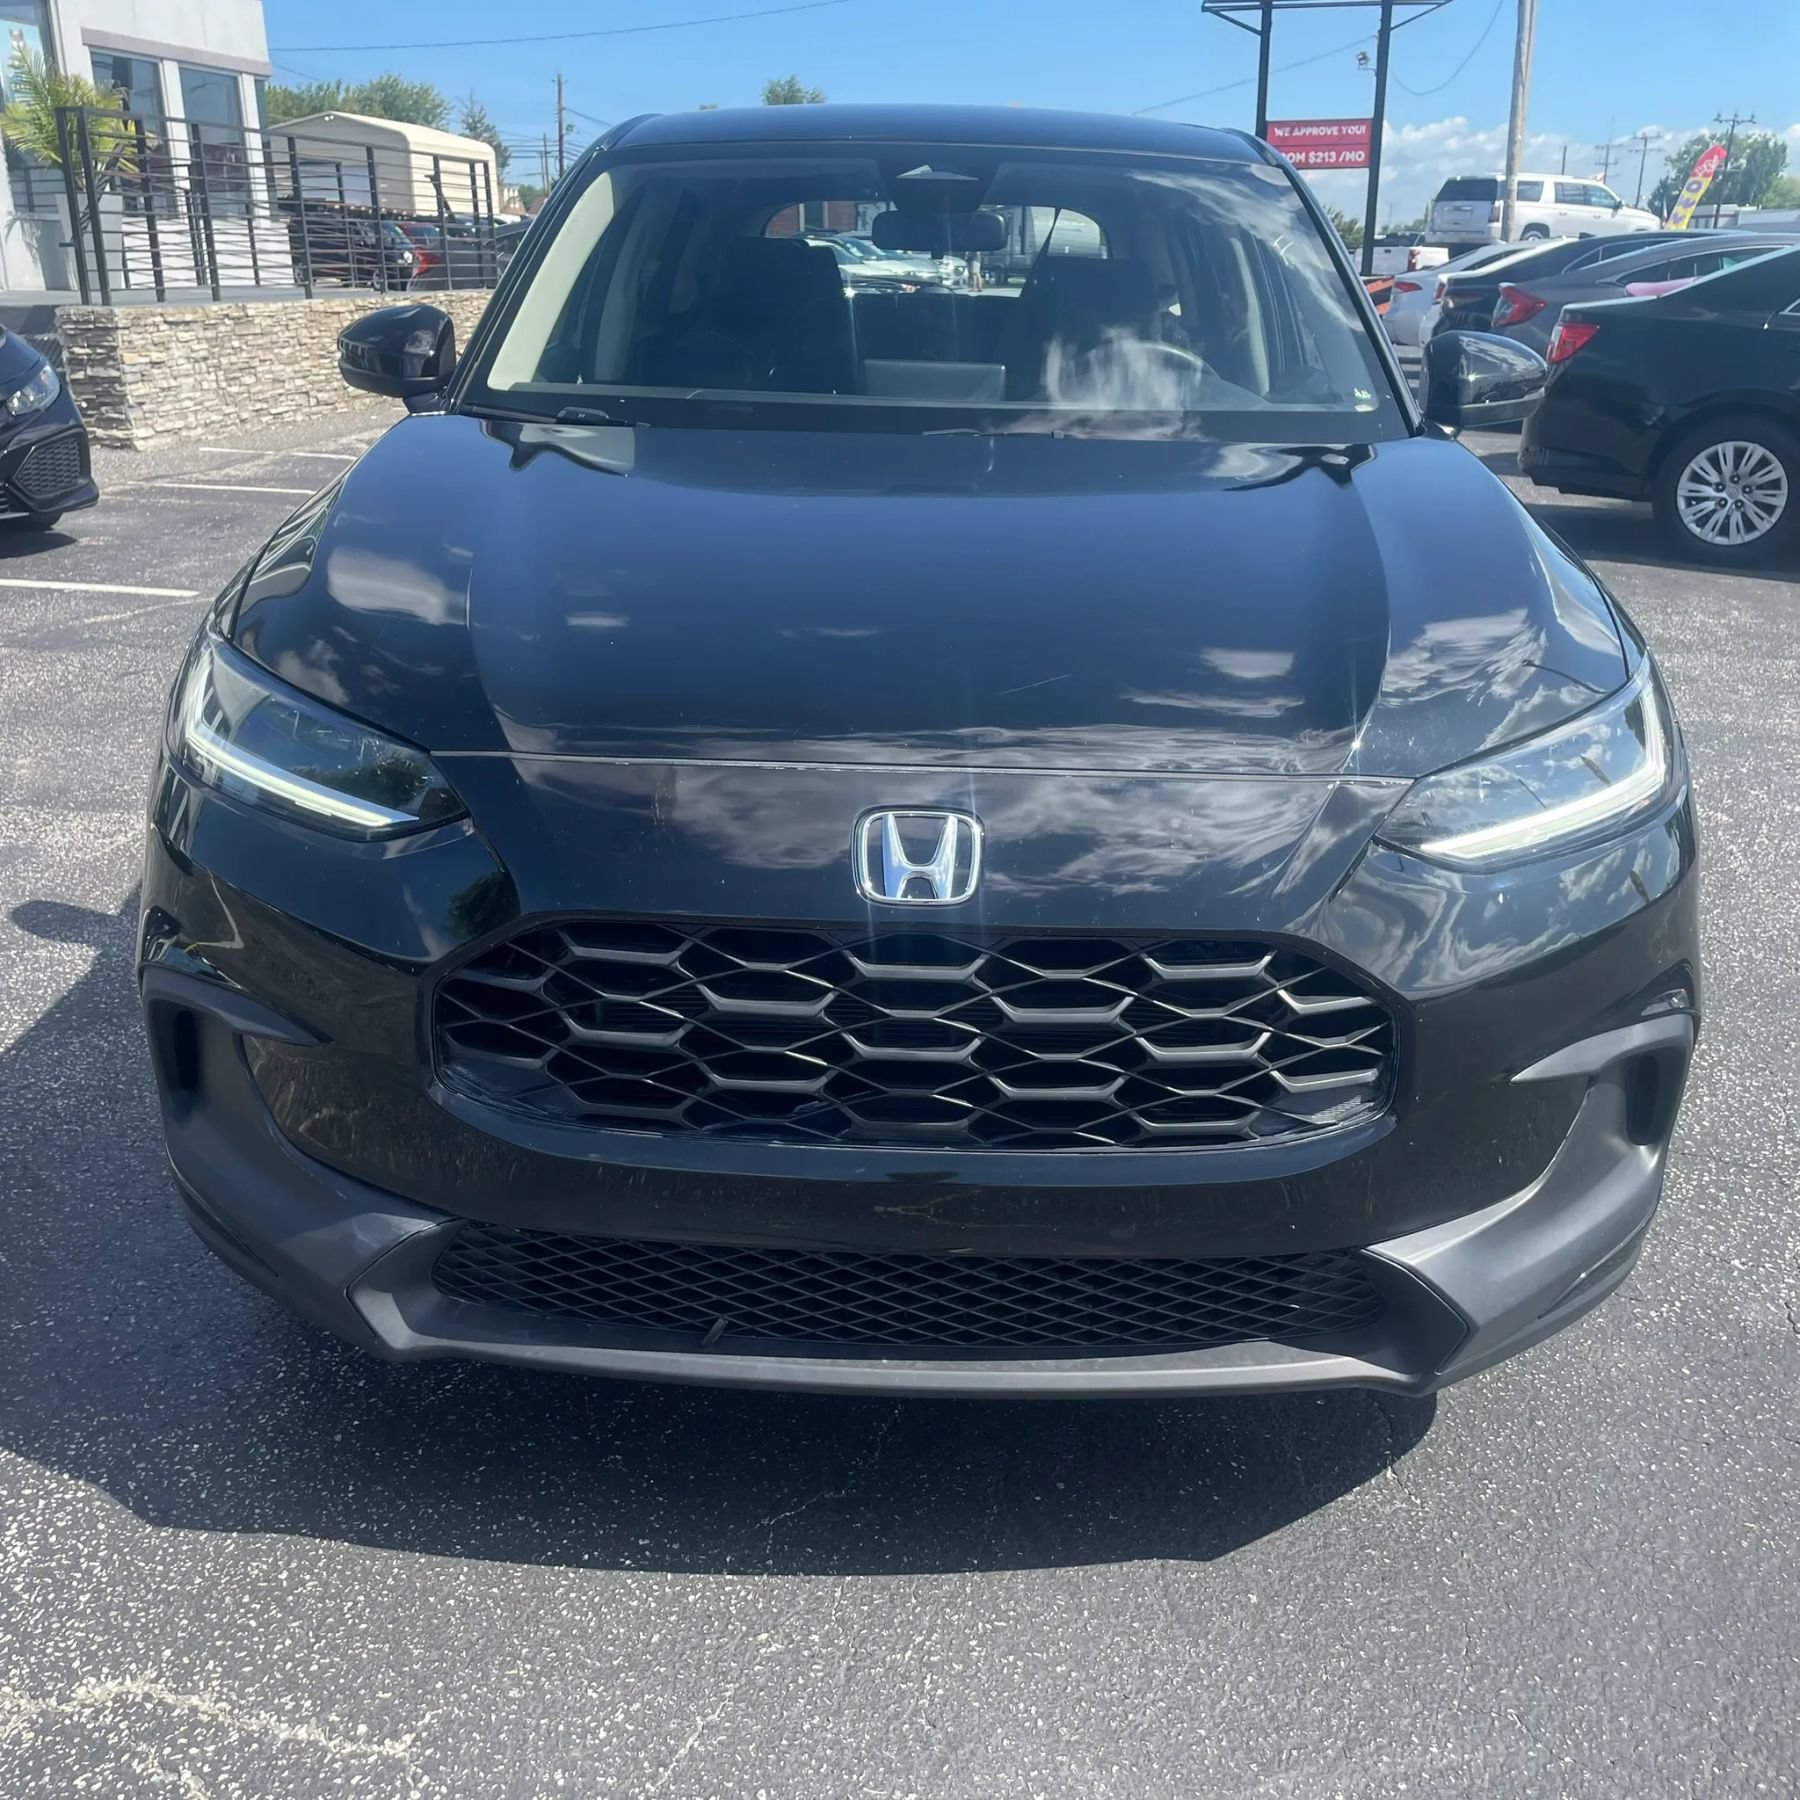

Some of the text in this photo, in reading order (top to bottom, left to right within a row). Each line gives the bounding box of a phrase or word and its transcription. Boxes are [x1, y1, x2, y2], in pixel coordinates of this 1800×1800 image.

[1274, 124, 1366, 137] WE APPROVE YOU!
[1308, 150, 1337, 164] $213
[1339, 150, 1366, 163] /MO
